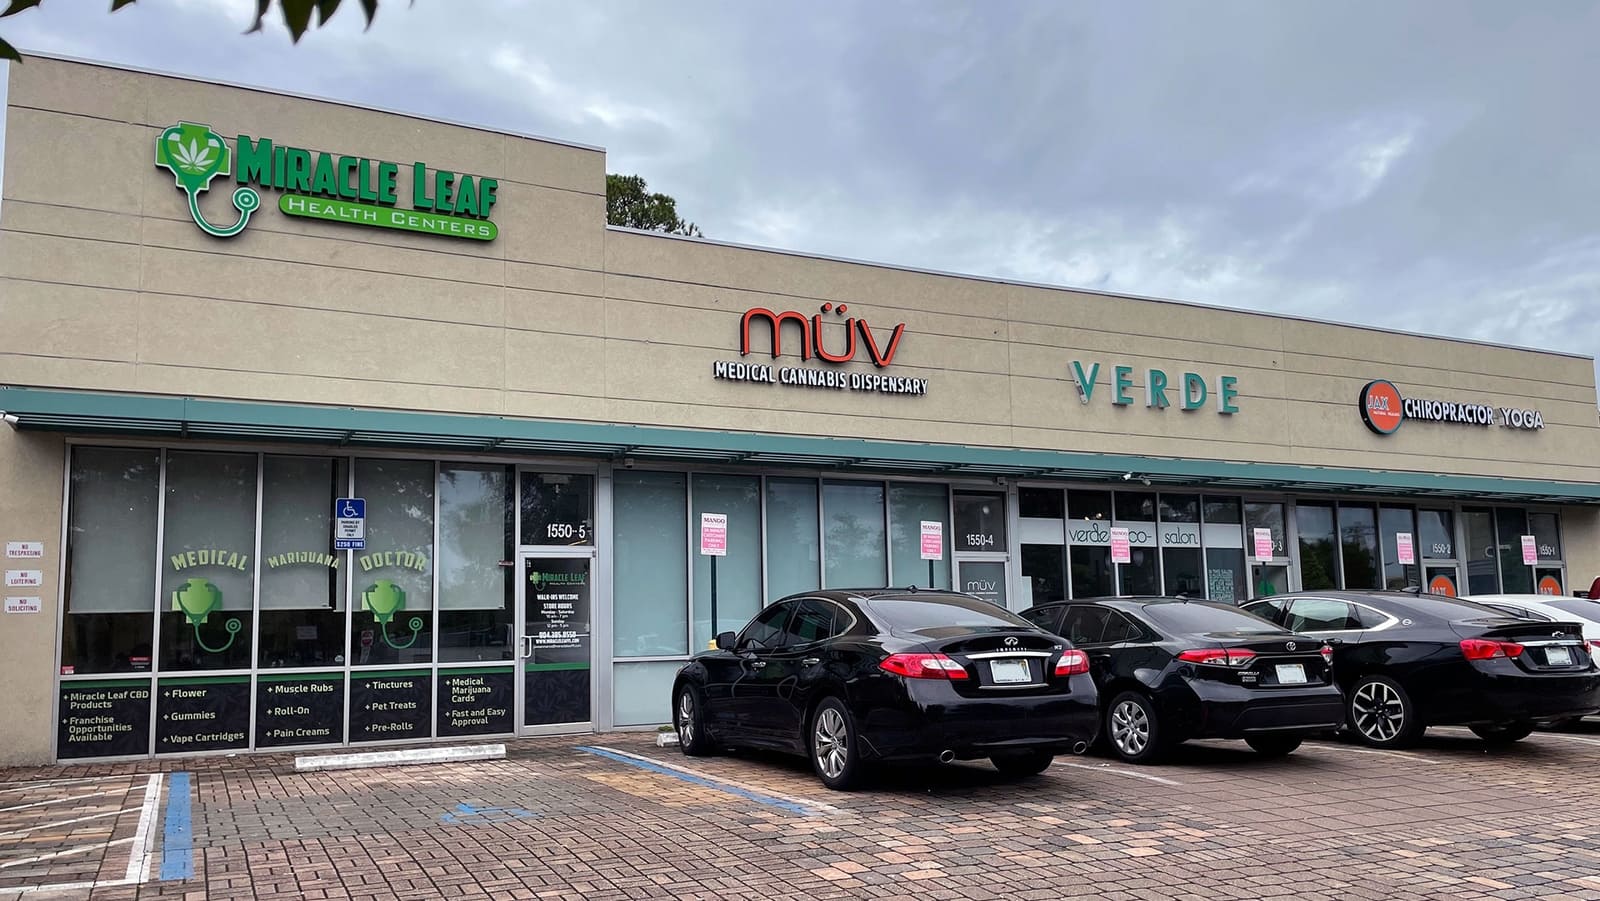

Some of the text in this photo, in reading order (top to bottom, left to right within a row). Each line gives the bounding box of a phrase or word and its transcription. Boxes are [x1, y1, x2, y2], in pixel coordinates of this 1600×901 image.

[237, 135, 499, 218] MIRACLE LEAF
[288, 198, 490, 236] HEALTH CENTERS
[740, 302, 905, 368] müv
[714, 361, 928, 395] MEDICAL CANNABIS DISPENSARY
[1068, 360, 1240, 413] VERDE
[1368, 395, 1389, 411] JAX
[1404, 398, 1544, 429] CHIROPRACTOR YOGA
[1069, 522, 1198, 544] verde co- salon
[966, 534, 993, 546] 1550-4
[1433, 543, 1451, 553] 1550-2
[171, 550, 249, 571] MEDICAL
[267, 551, 340, 569] MARIJUANA
[360, 551, 427, 571] DOCTOR
[967, 579, 995, 591] müv
[373, 681, 413, 689] Tinctures
[452, 677, 484, 686] Medical
[172, 689, 207, 698] Flower
[275, 684, 333, 694] Muscle Rubs
[452, 686, 491, 695] Marijuana
[70, 690, 149, 700] Miracle Leaf CBD
[451, 695, 475, 703] Cards
[71, 701, 112, 709] Products
[372, 701, 417, 711] Pet Treats
[171, 711, 216, 721] Gummies
[274, 706, 310, 716] Roll-On
[470, 708, 485, 716] and
[487, 708, 506, 716] Easy
[70, 716, 114, 725] Franchise
[451, 717, 488, 727] Approval
[69, 723, 132, 734] Opportunities
[372, 722, 413, 732] Pre-Rolls
[171, 731, 245, 744] Vape Cartridges
[273, 728, 330, 737] Pain Creams
[69, 734, 113, 742] Available
